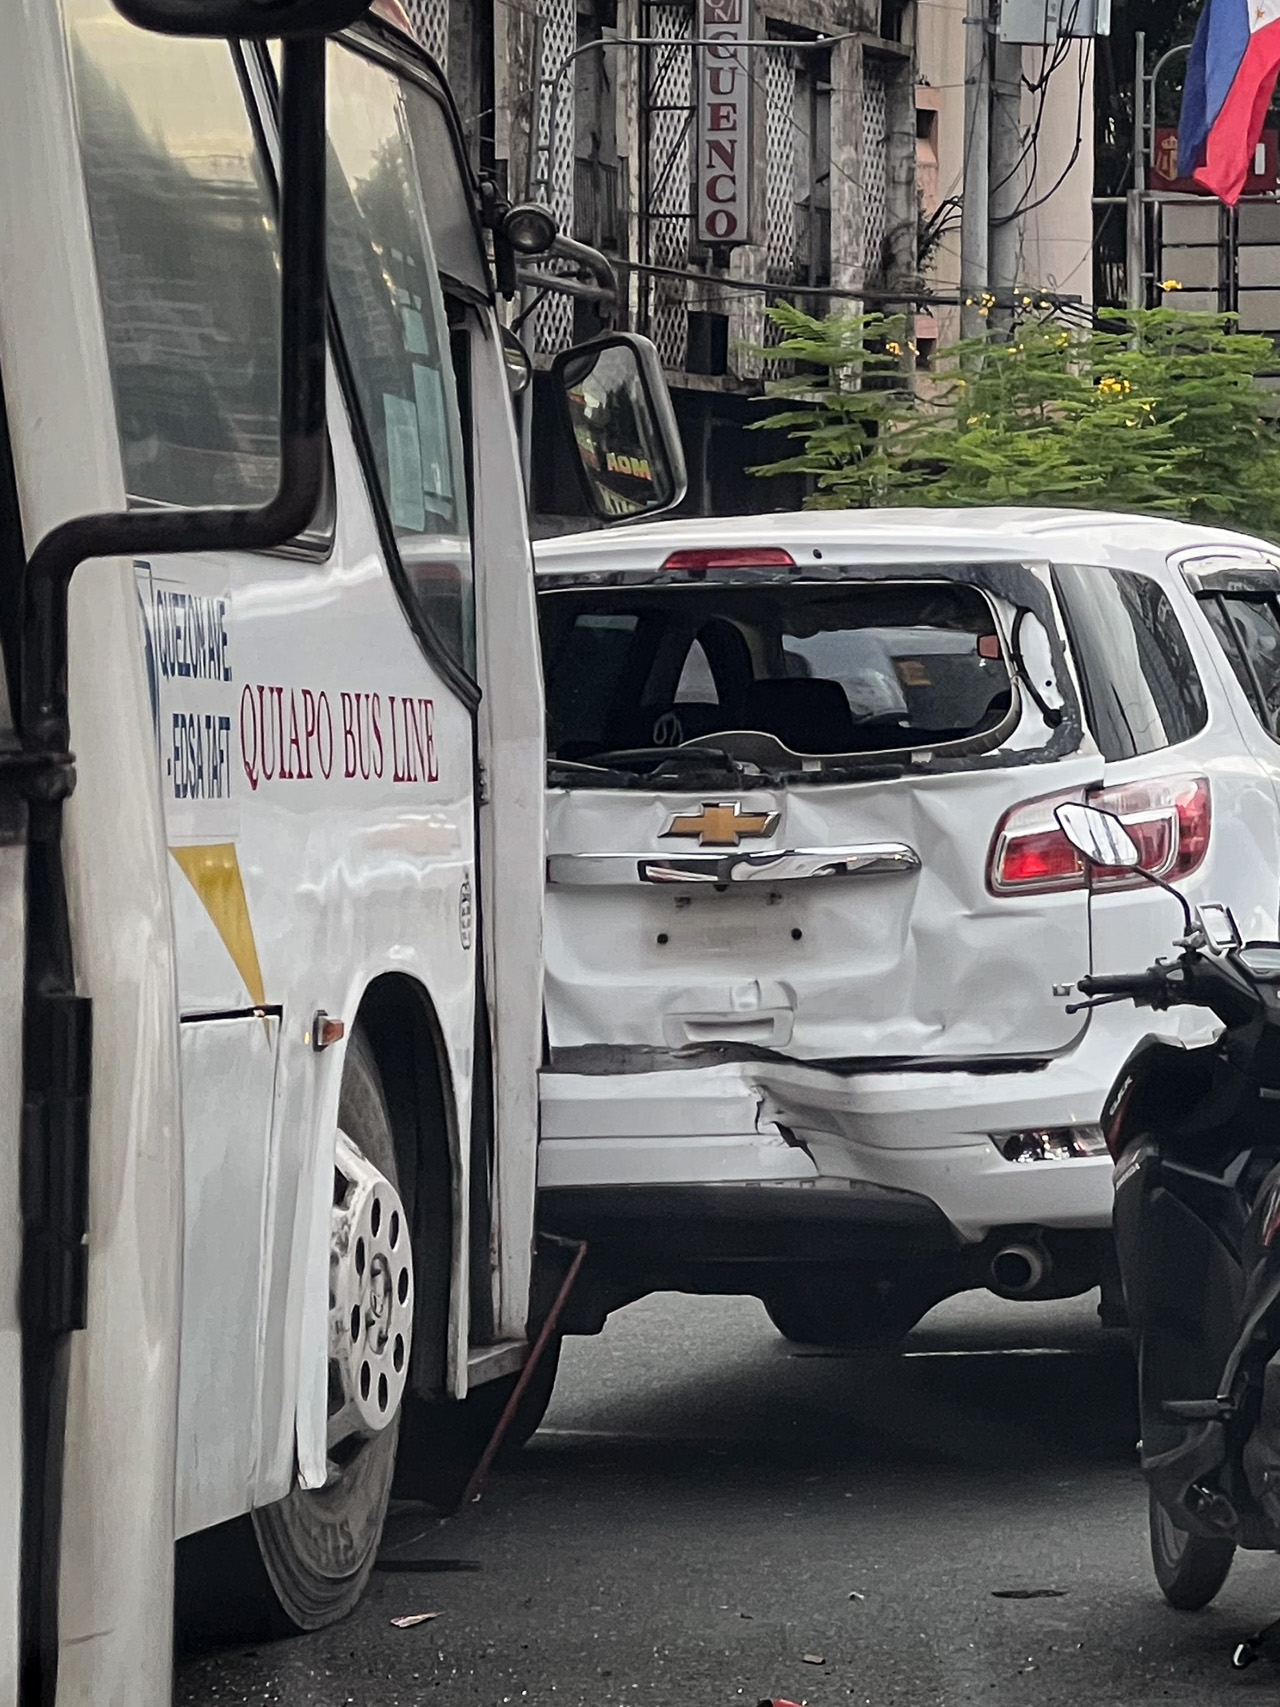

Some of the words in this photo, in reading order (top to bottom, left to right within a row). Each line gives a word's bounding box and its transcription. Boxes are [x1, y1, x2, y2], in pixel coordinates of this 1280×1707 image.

[705, 31, 737, 238] CUENCO
[156, 590, 206, 680] QUEZON
[205, 714, 231, 799] TAFT
[240, 684, 333, 790] QUIAPO
[340, 692, 384, 780] BUS
[388, 696, 439, 783] LINE
